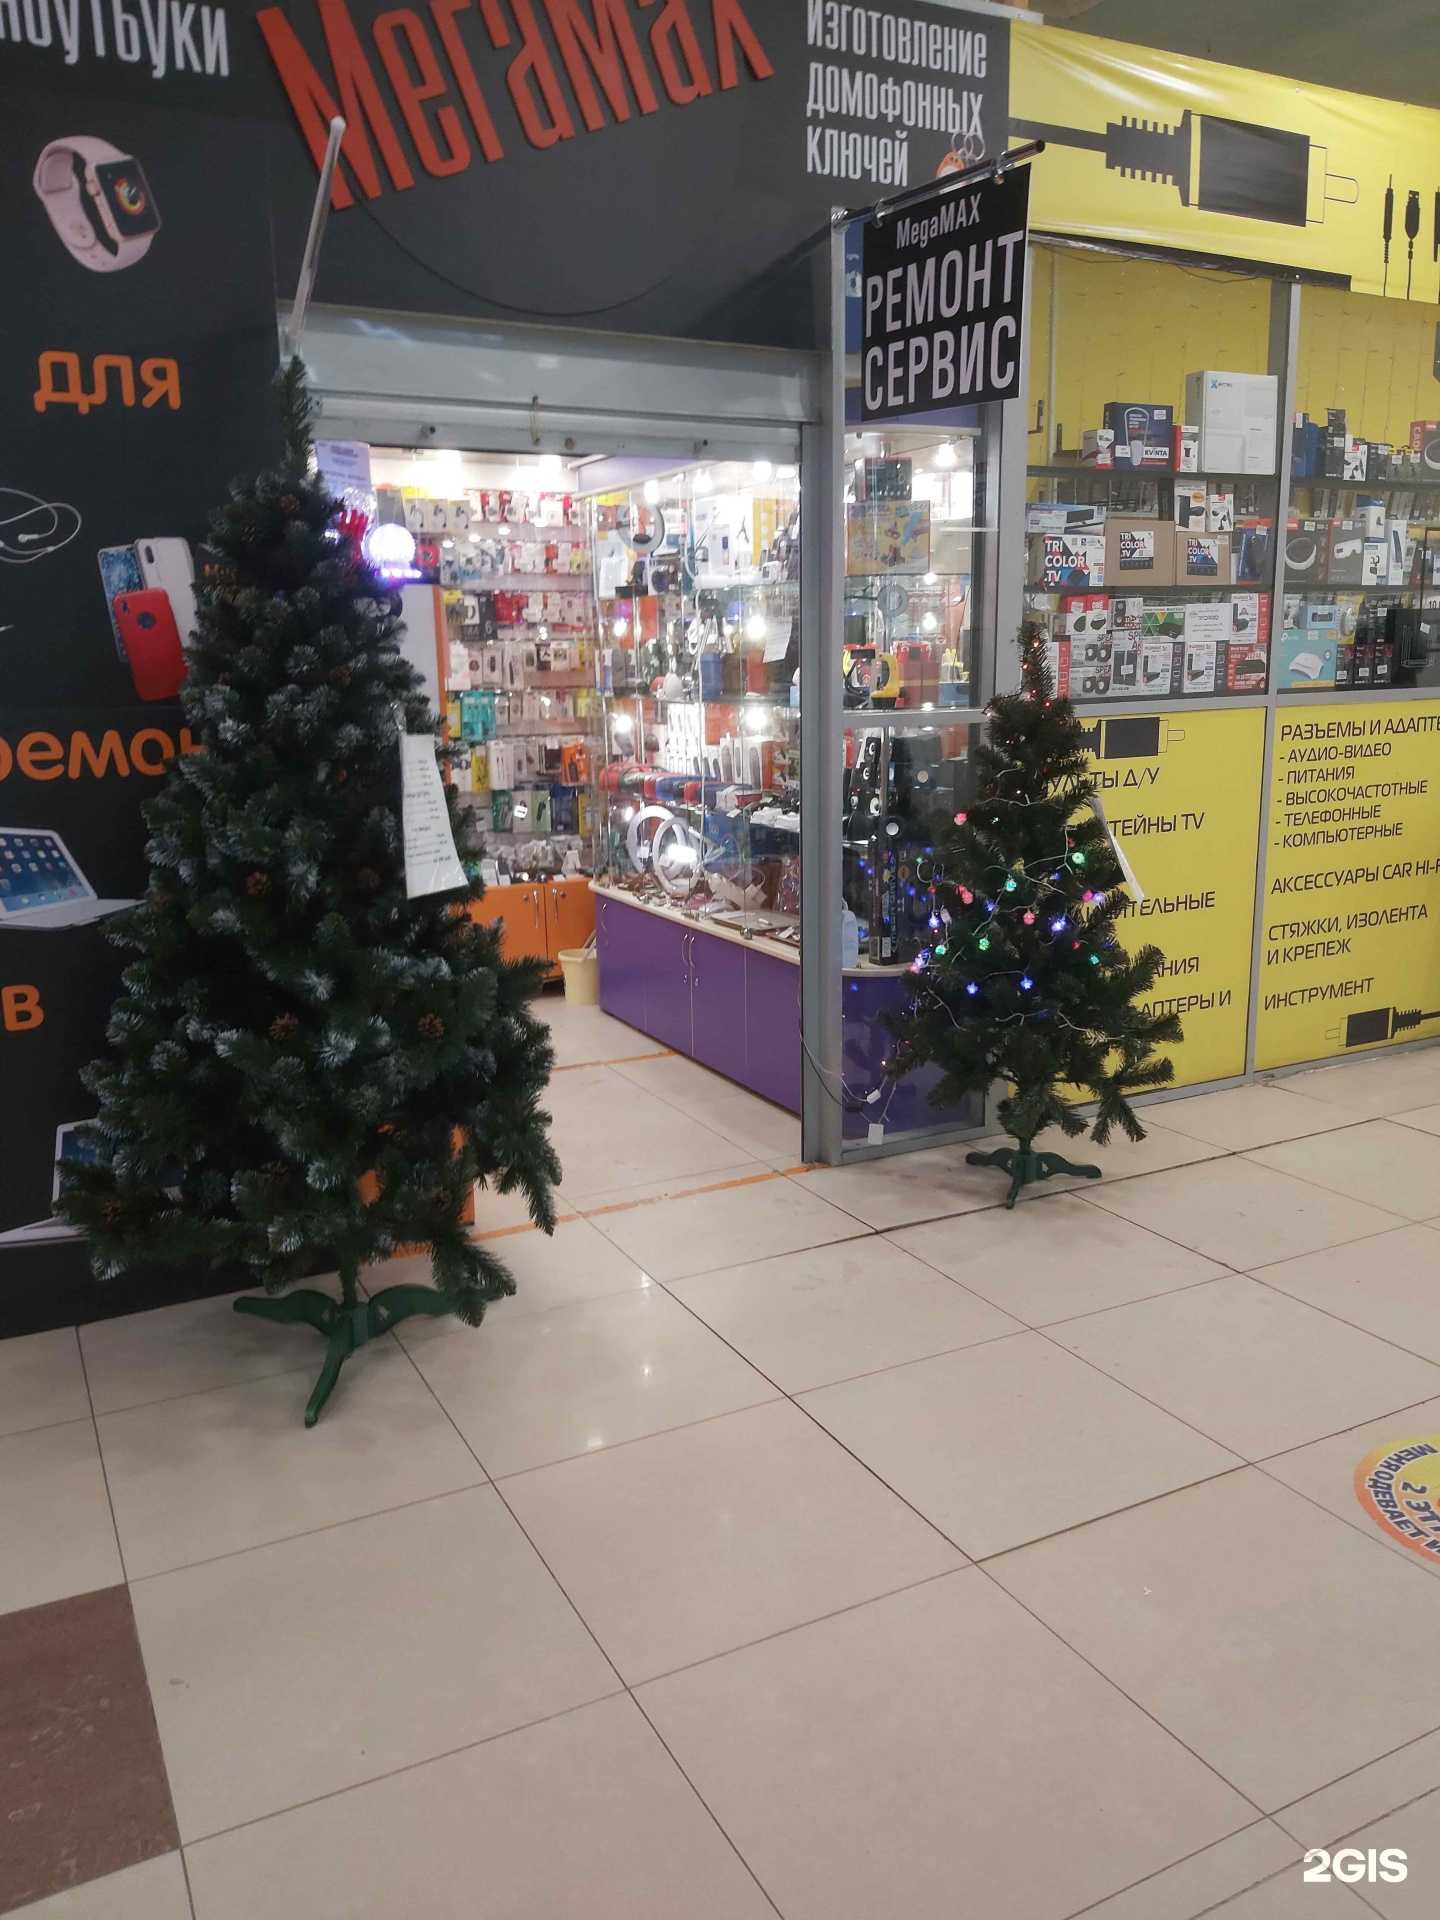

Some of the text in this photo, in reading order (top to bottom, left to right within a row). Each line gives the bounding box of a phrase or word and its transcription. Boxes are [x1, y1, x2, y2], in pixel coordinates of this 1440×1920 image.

[897, 192, 982, 249] MegaMAX
[865, 230, 1024, 338] РЕМОНТ
[864, 315, 1017, 411] СЕРВИС
[1044, 540, 1063, 552] TRI
[1120, 532, 1131, 540] TRI
[1120, 541, 1144, 549] COLOR
[1044, 555, 1086, 568] COLOR
[1187, 547, 1209, 555] COLOR
[1280, 720, 1366, 741] РАЗЪЕМЫ
[1370, 719, 1381, 735] И
[1288, 742, 1392, 763] АУДИО-ВИДЕО
[1287, 766, 1355, 784] ПИТАНИЯ
[1285, 780, 1428, 806] ВЫСОКОЧАСТОТНЫЕ
[1106, 812, 1205, 838] ТЕЙНЫ TV
[1284, 805, 1382, 827] ТЕЛЕФОННЫЕ
[1283, 823, 1404, 848] КОМПЬЮТЕРНЫЕ
[1271, 866, 1379, 894] АКСЕССУАРЫ
[1383, 862, 1412, 880] CAR
[1108, 891, 1216, 920] ТЕЛЬНЫЕ
[1268, 904, 1428, 941] СТЯЖКИ, ИЗОЛЕНТА
[1267, 938, 1352, 965] И КРЕПЕЖ
[1153, 956, 1200, 978] АНИЯ
[1141, 990, 1232, 1019] АПТЕРЫ И
[1264, 977, 1375, 1010] ИНСТРУМЕНТ
[1405, 1500, 1440, 1532] ЭТ
